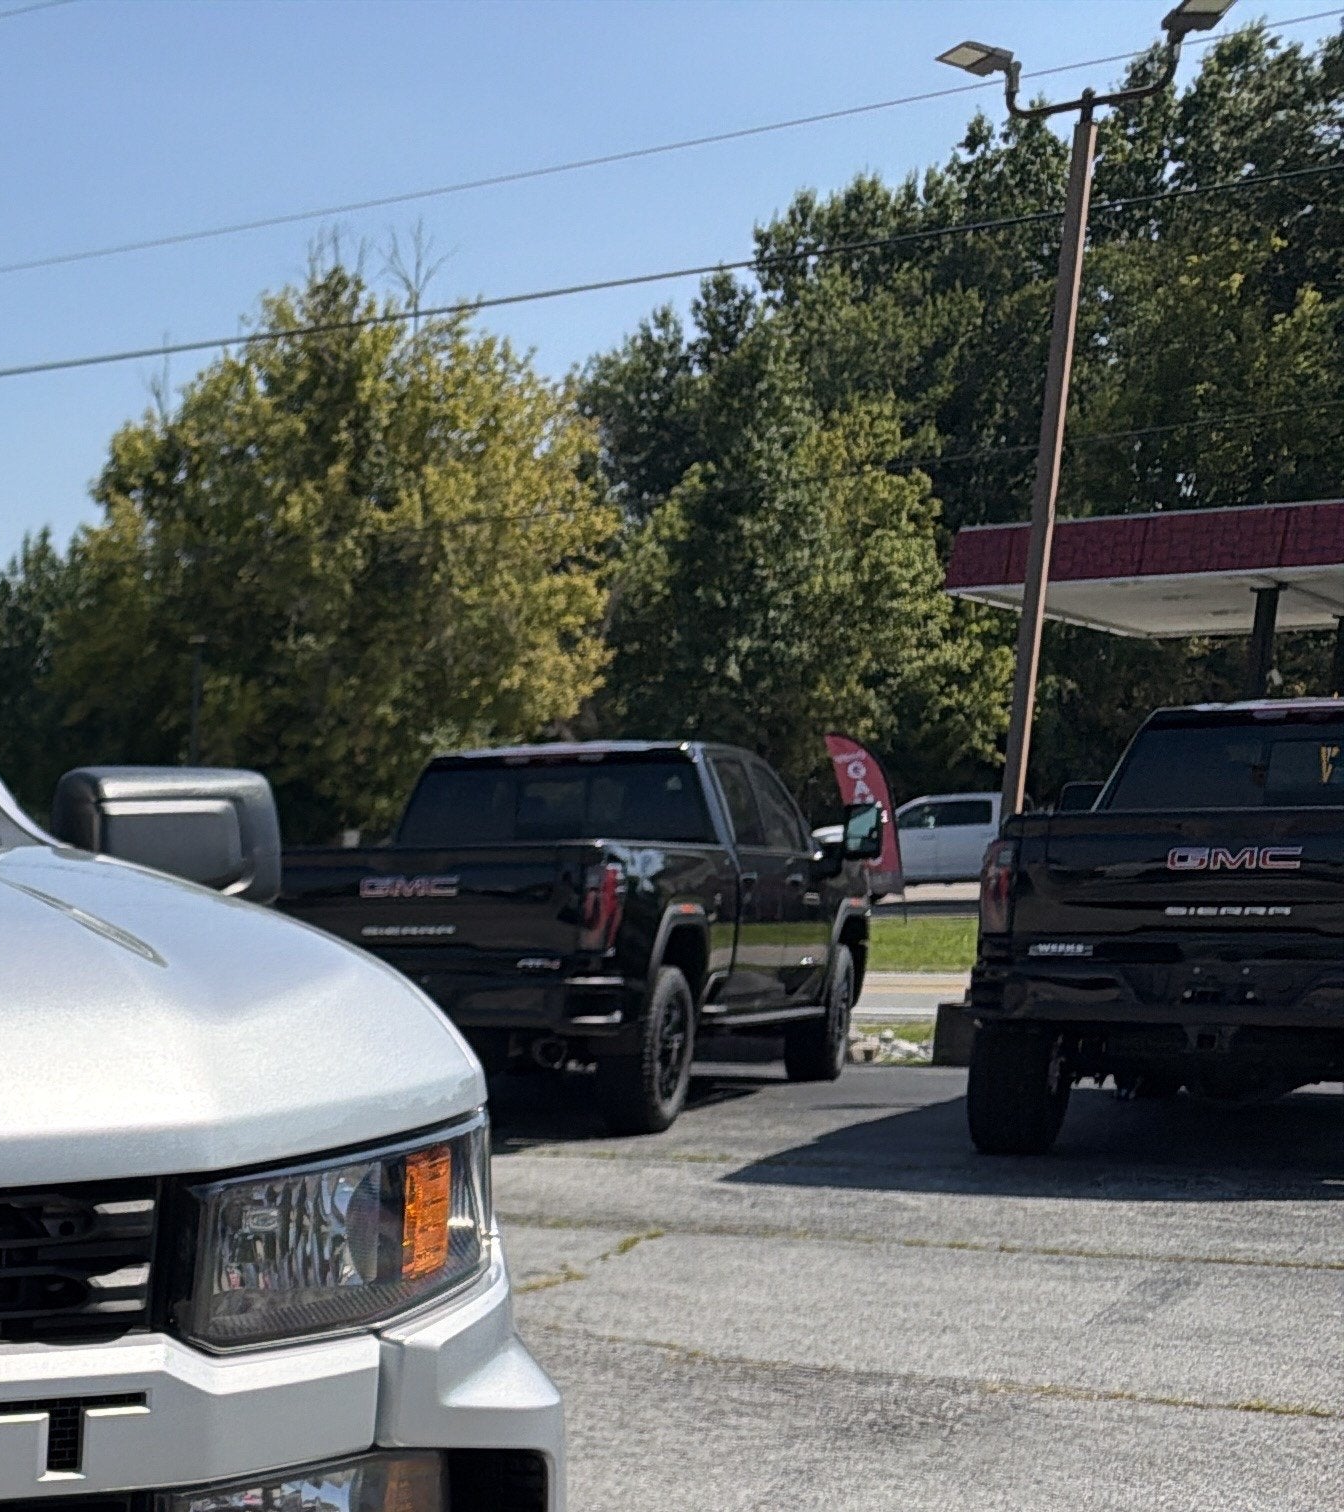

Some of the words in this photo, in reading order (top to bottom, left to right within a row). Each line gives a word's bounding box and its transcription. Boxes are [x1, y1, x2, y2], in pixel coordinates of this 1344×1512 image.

[1168, 847, 1302, 870] GMC
[360, 875, 460, 897] GMC
[1165, 906, 1291, 915] SIERRA
